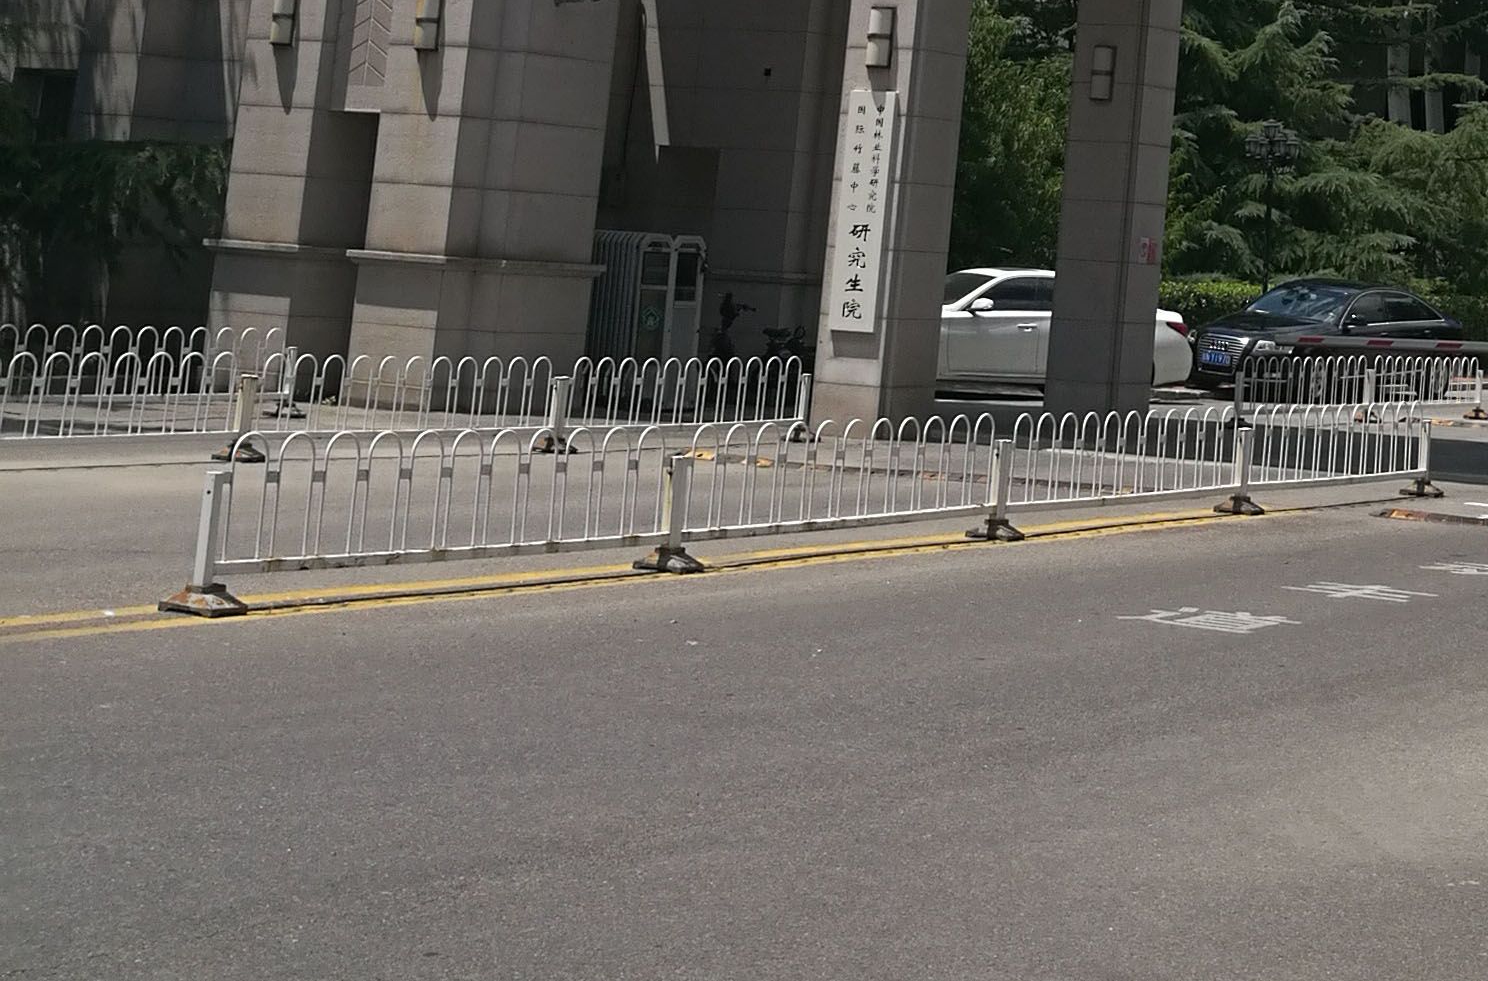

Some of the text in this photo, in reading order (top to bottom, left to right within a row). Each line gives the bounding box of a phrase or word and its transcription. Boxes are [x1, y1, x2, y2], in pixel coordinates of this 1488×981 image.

[866, 103, 885, 214] 中国林业科学研究院
[841, 224, 871, 320] 研究生院
